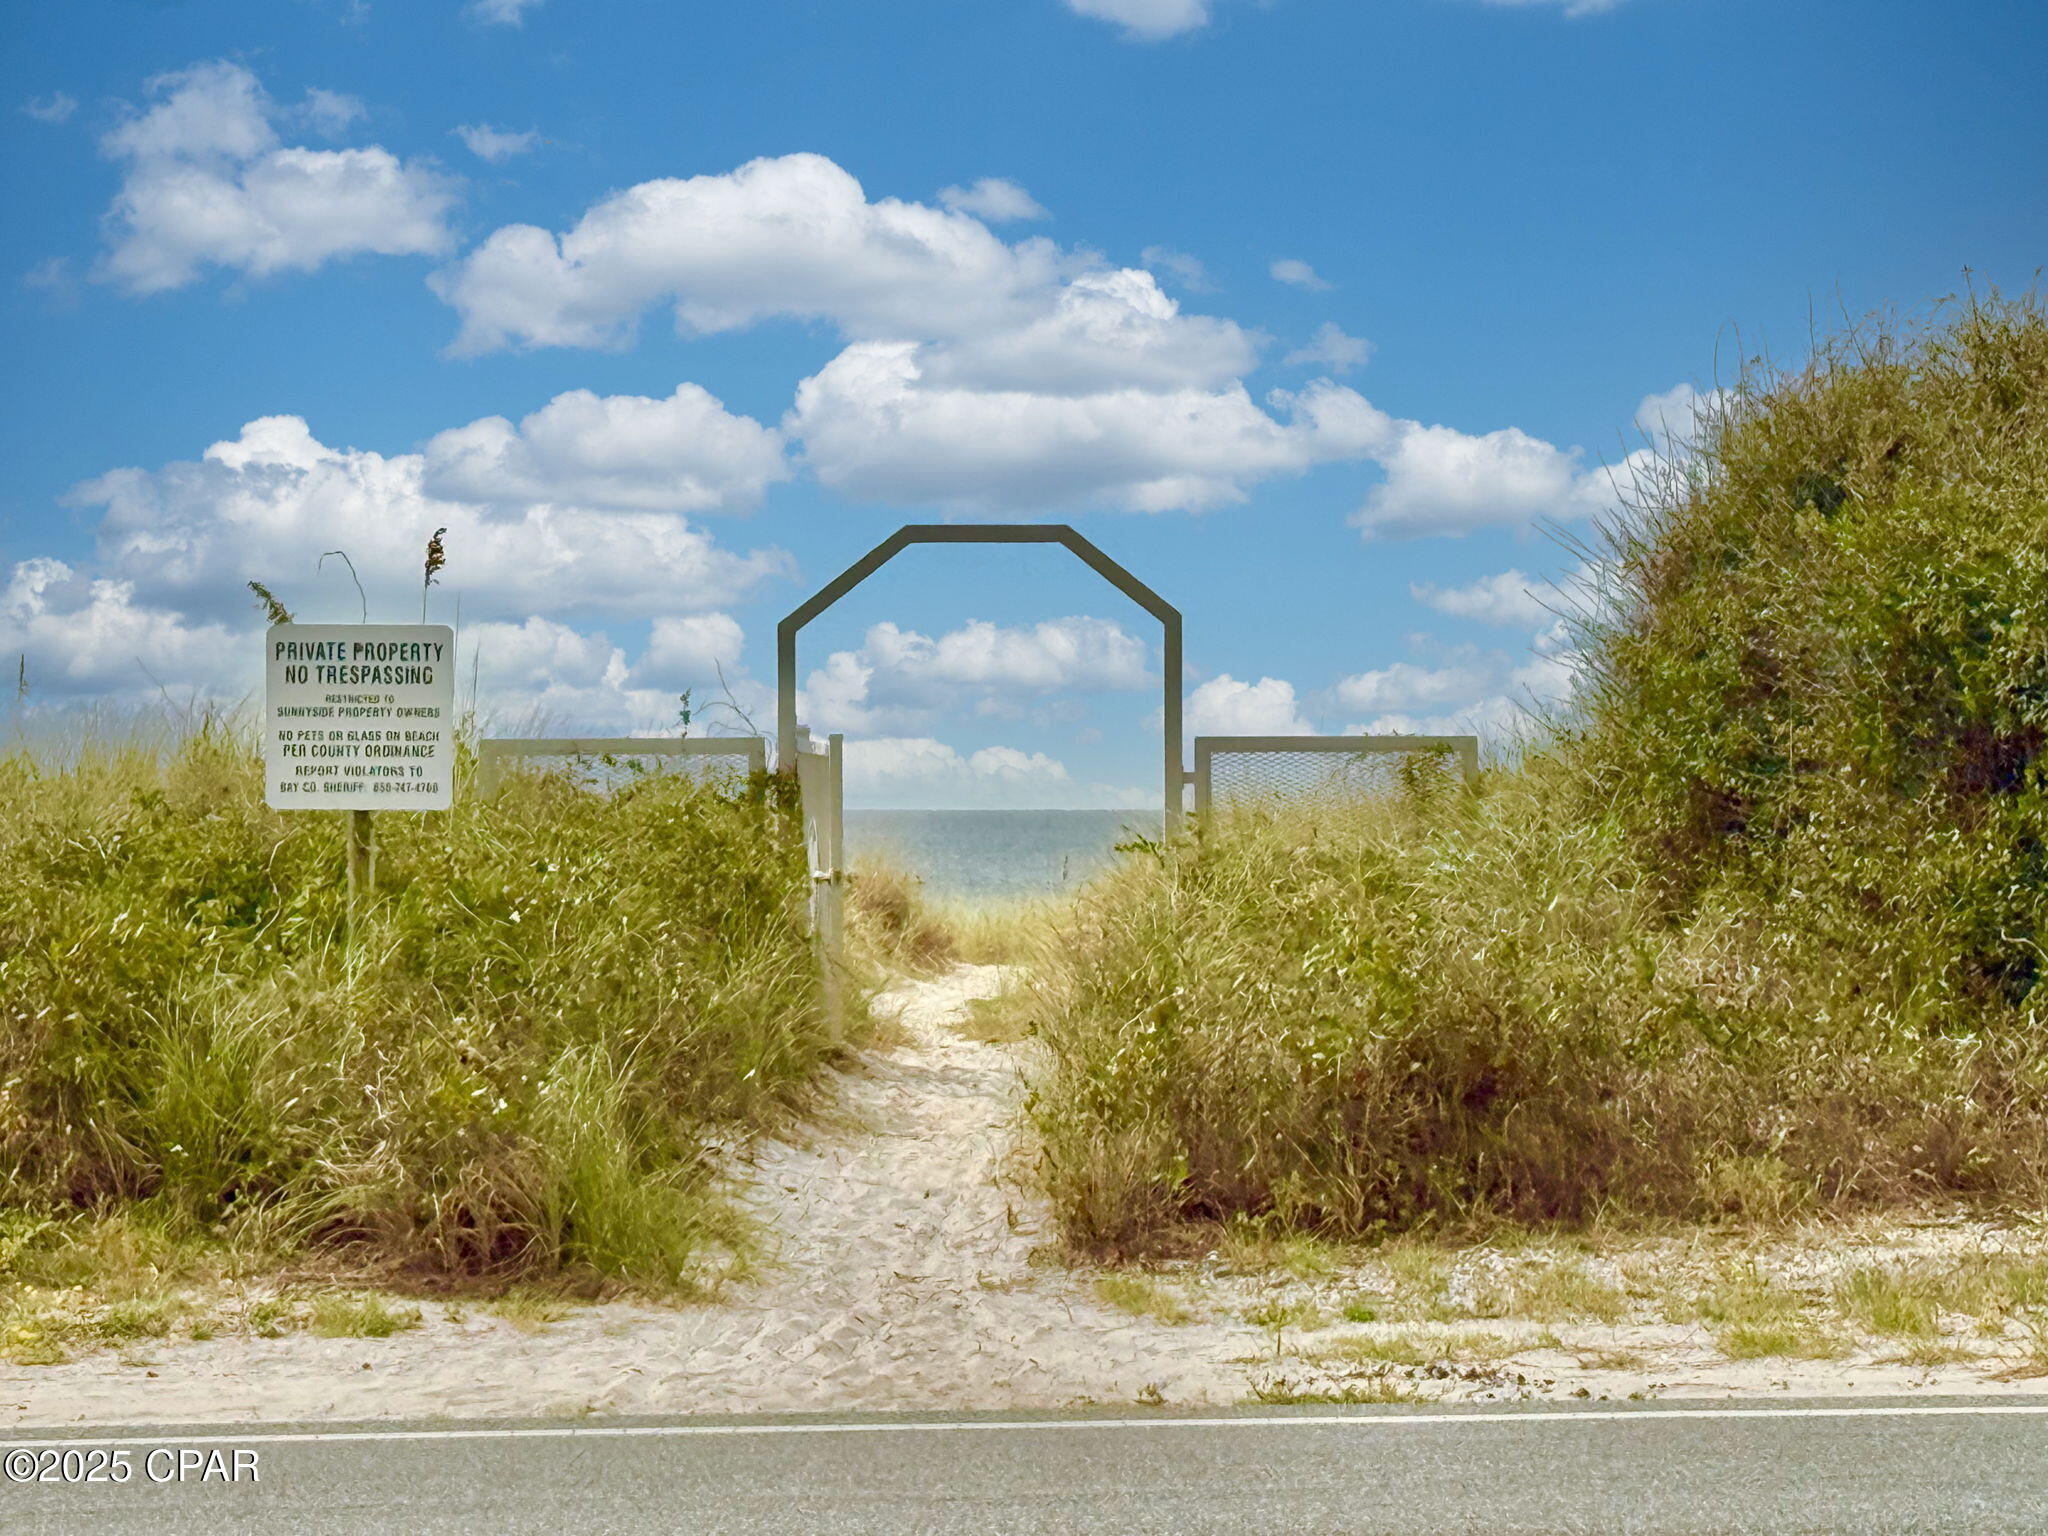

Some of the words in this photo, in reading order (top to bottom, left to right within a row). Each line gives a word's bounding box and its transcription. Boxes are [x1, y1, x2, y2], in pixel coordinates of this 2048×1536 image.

[276, 642, 346, 661] PRIVATE
[353, 643, 443, 662] PROPERTY
[286, 665, 308, 684] NO
[316, 666, 433, 684] TRESPASSING
[338, 708, 392, 717] PROPERTY
[397, 708, 440, 718] OWNERS
[279, 731, 293, 740] NO
[298, 731, 324, 740] PETS
[329, 731, 343, 740] OR
[348, 731, 381, 741] GLASS
[386, 731, 400, 740] ON
[405, 731, 439, 741] BEACH
[283, 745, 305, 757] PER
[312, 745, 359, 757] COUNTY
[365, 745, 435, 757] ORDINANCE
[296, 766, 339, 776] REPORT
[344, 766, 404, 776] VIOLATORS
[410, 766, 422, 776] TO
[280, 782, 298, 792] BAY
